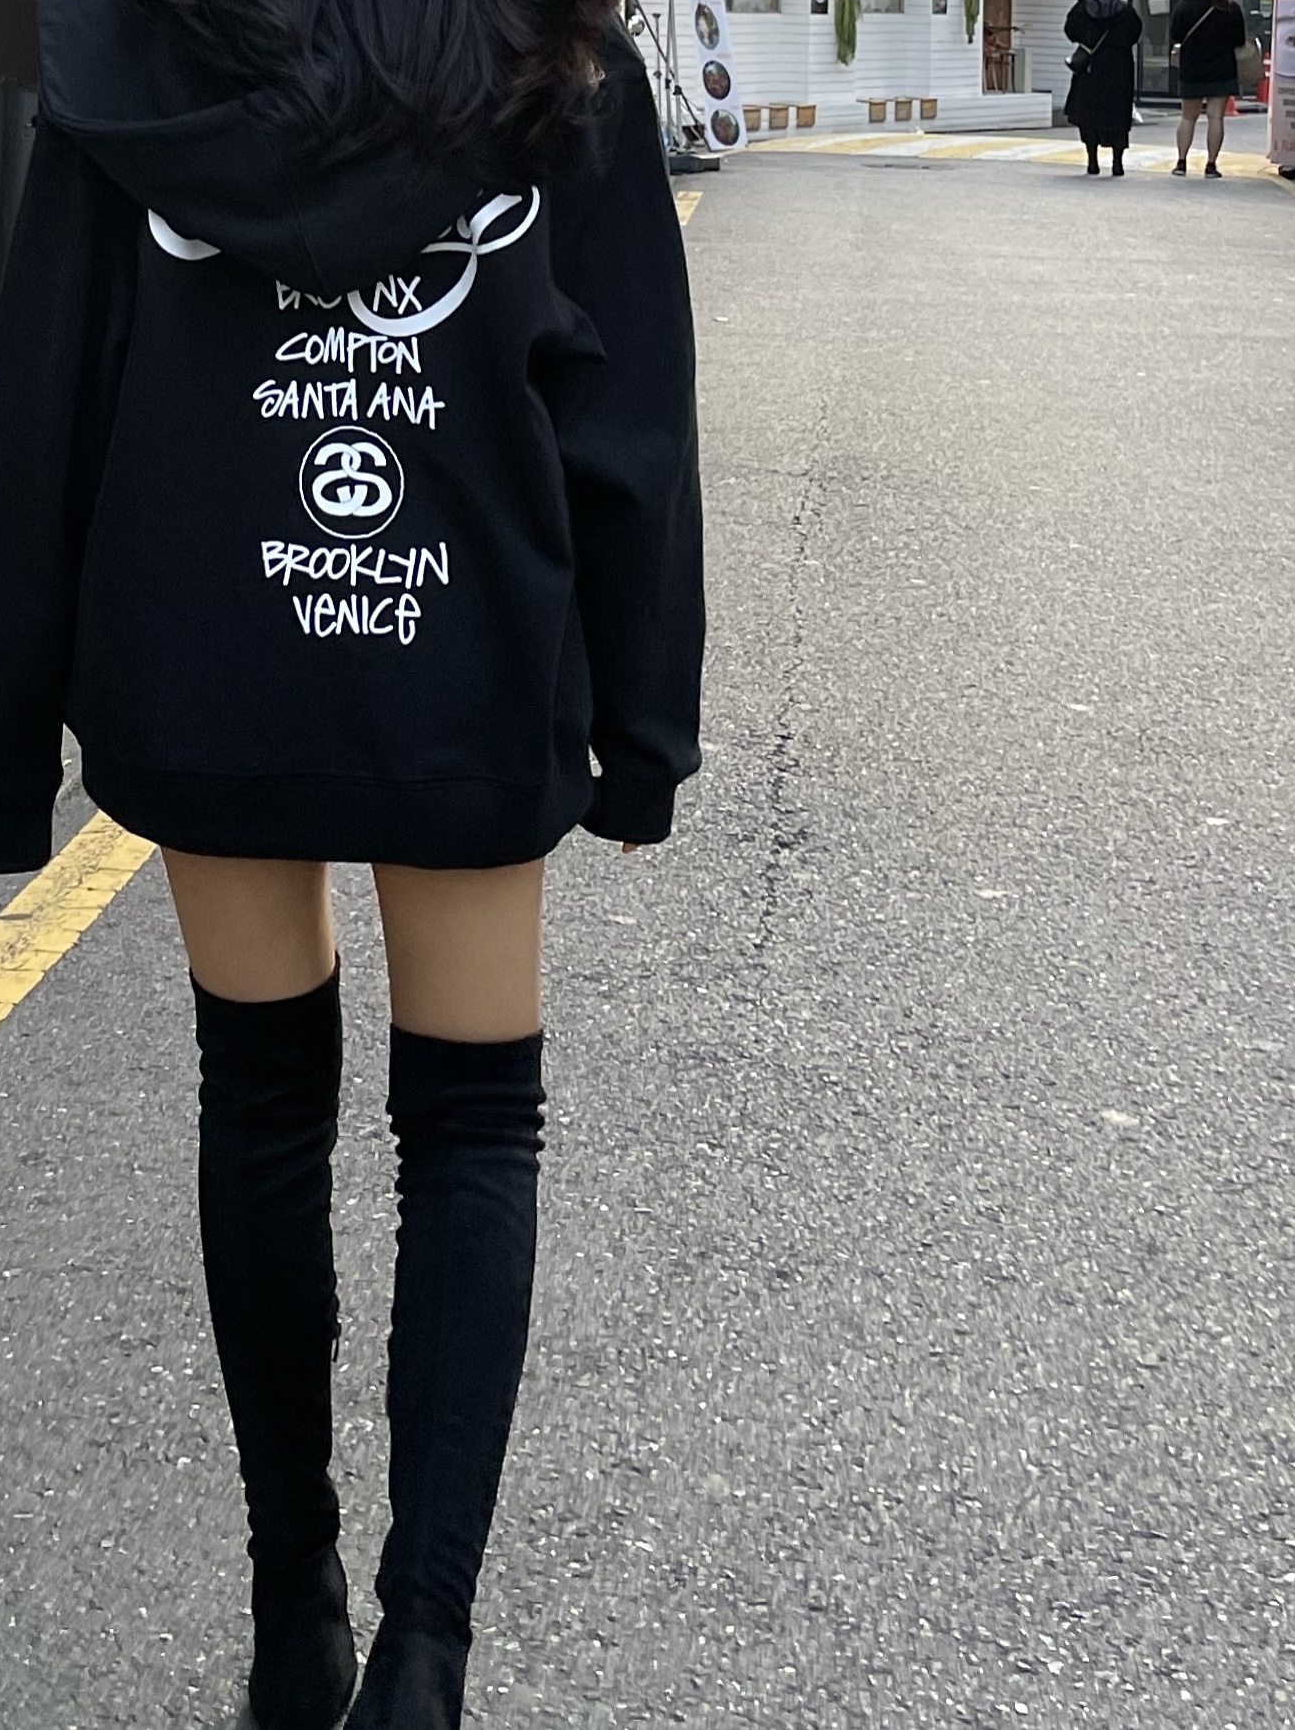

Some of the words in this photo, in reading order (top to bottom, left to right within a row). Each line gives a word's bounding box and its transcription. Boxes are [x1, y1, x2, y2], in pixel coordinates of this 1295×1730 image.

[275, 326, 421, 374] COMPTON
[252, 378, 358, 421] SANTA
[366, 381, 446, 430] ANA
[261, 540, 449, 589] BROOKLYN
